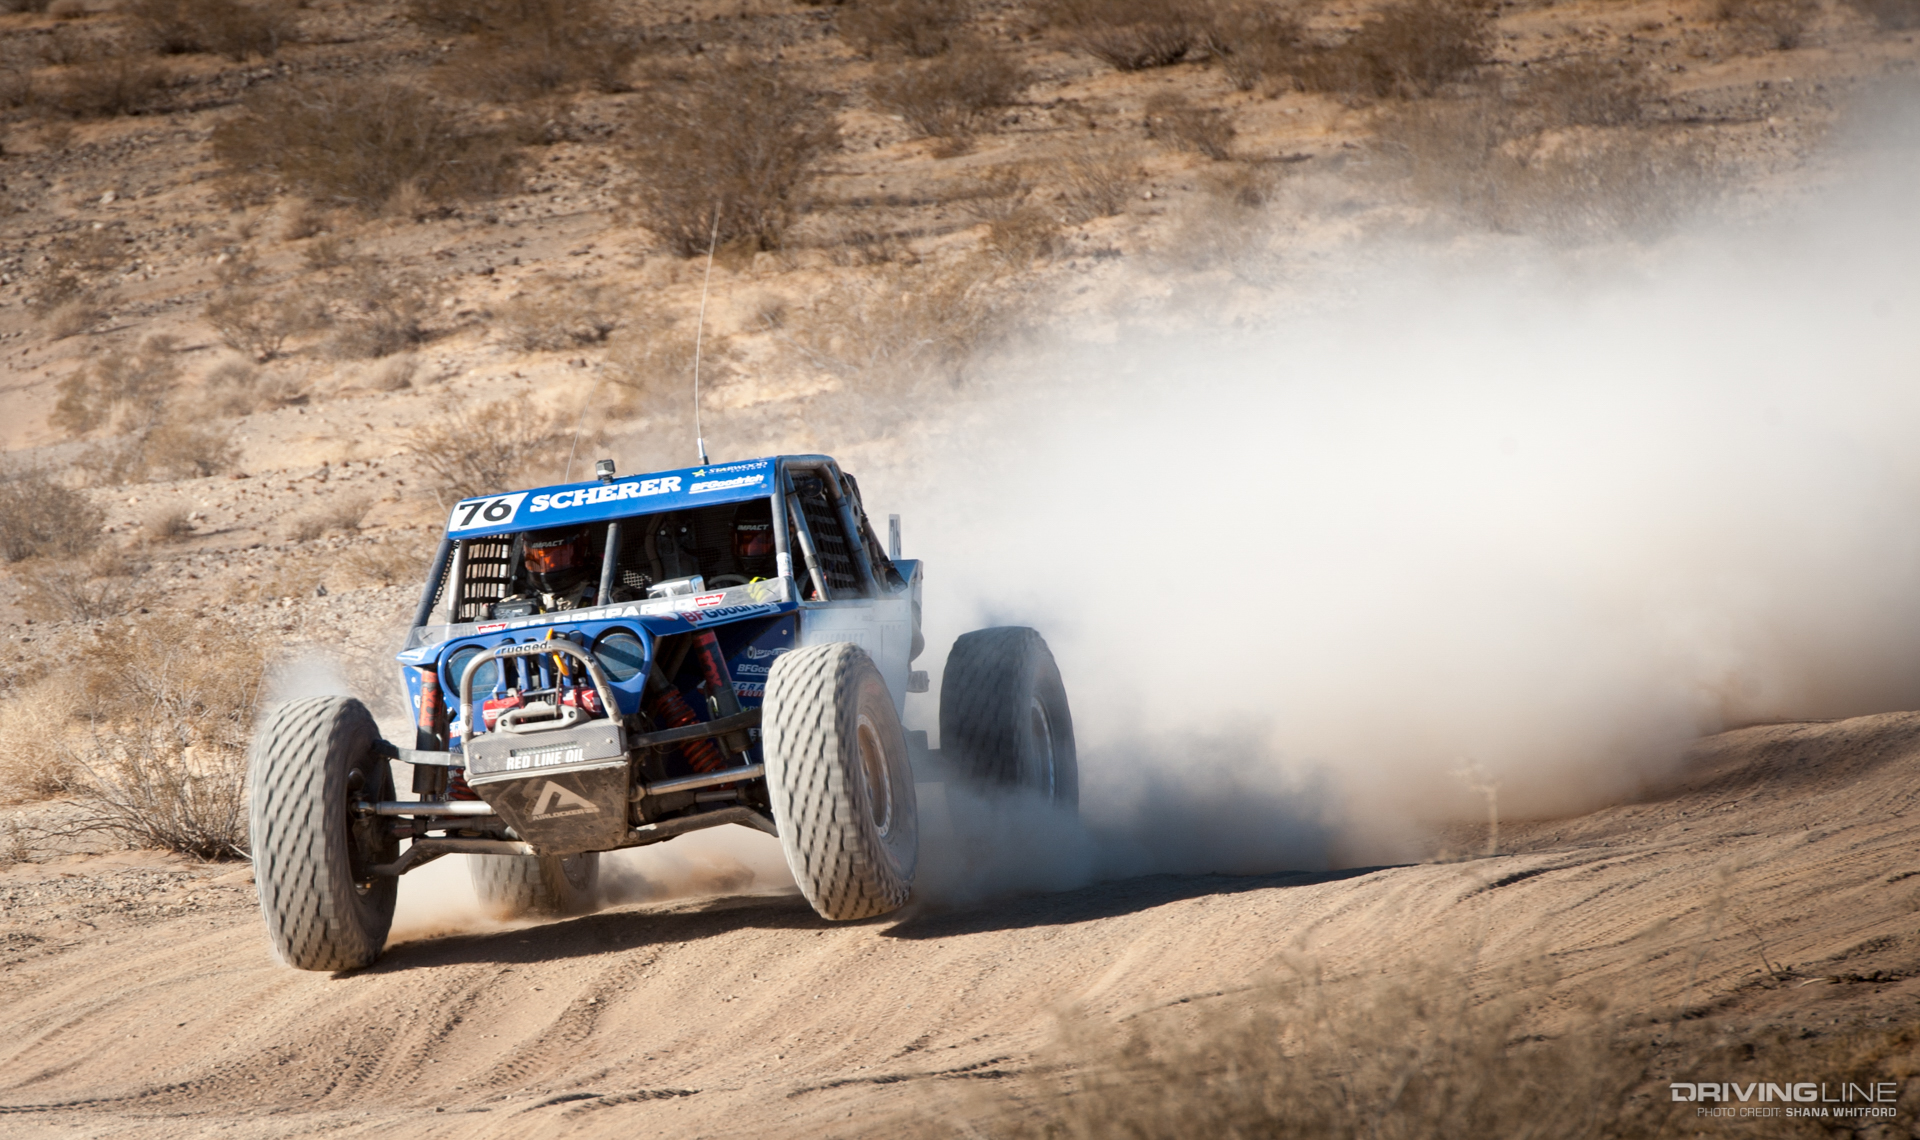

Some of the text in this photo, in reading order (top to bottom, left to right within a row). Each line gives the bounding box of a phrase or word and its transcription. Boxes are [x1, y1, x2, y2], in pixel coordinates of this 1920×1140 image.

[708, 461, 768, 474] STARWOOD
[690, 474, 765, 492] BFGoodrich
[459, 476, 682, 527] 76 SCHERER
[532, 539, 565, 548] IMPACT
[681, 602, 774, 622] BFGoodric
[737, 664, 770, 673] BFGoo
[506, 748, 585, 770] RED LINE OIL
